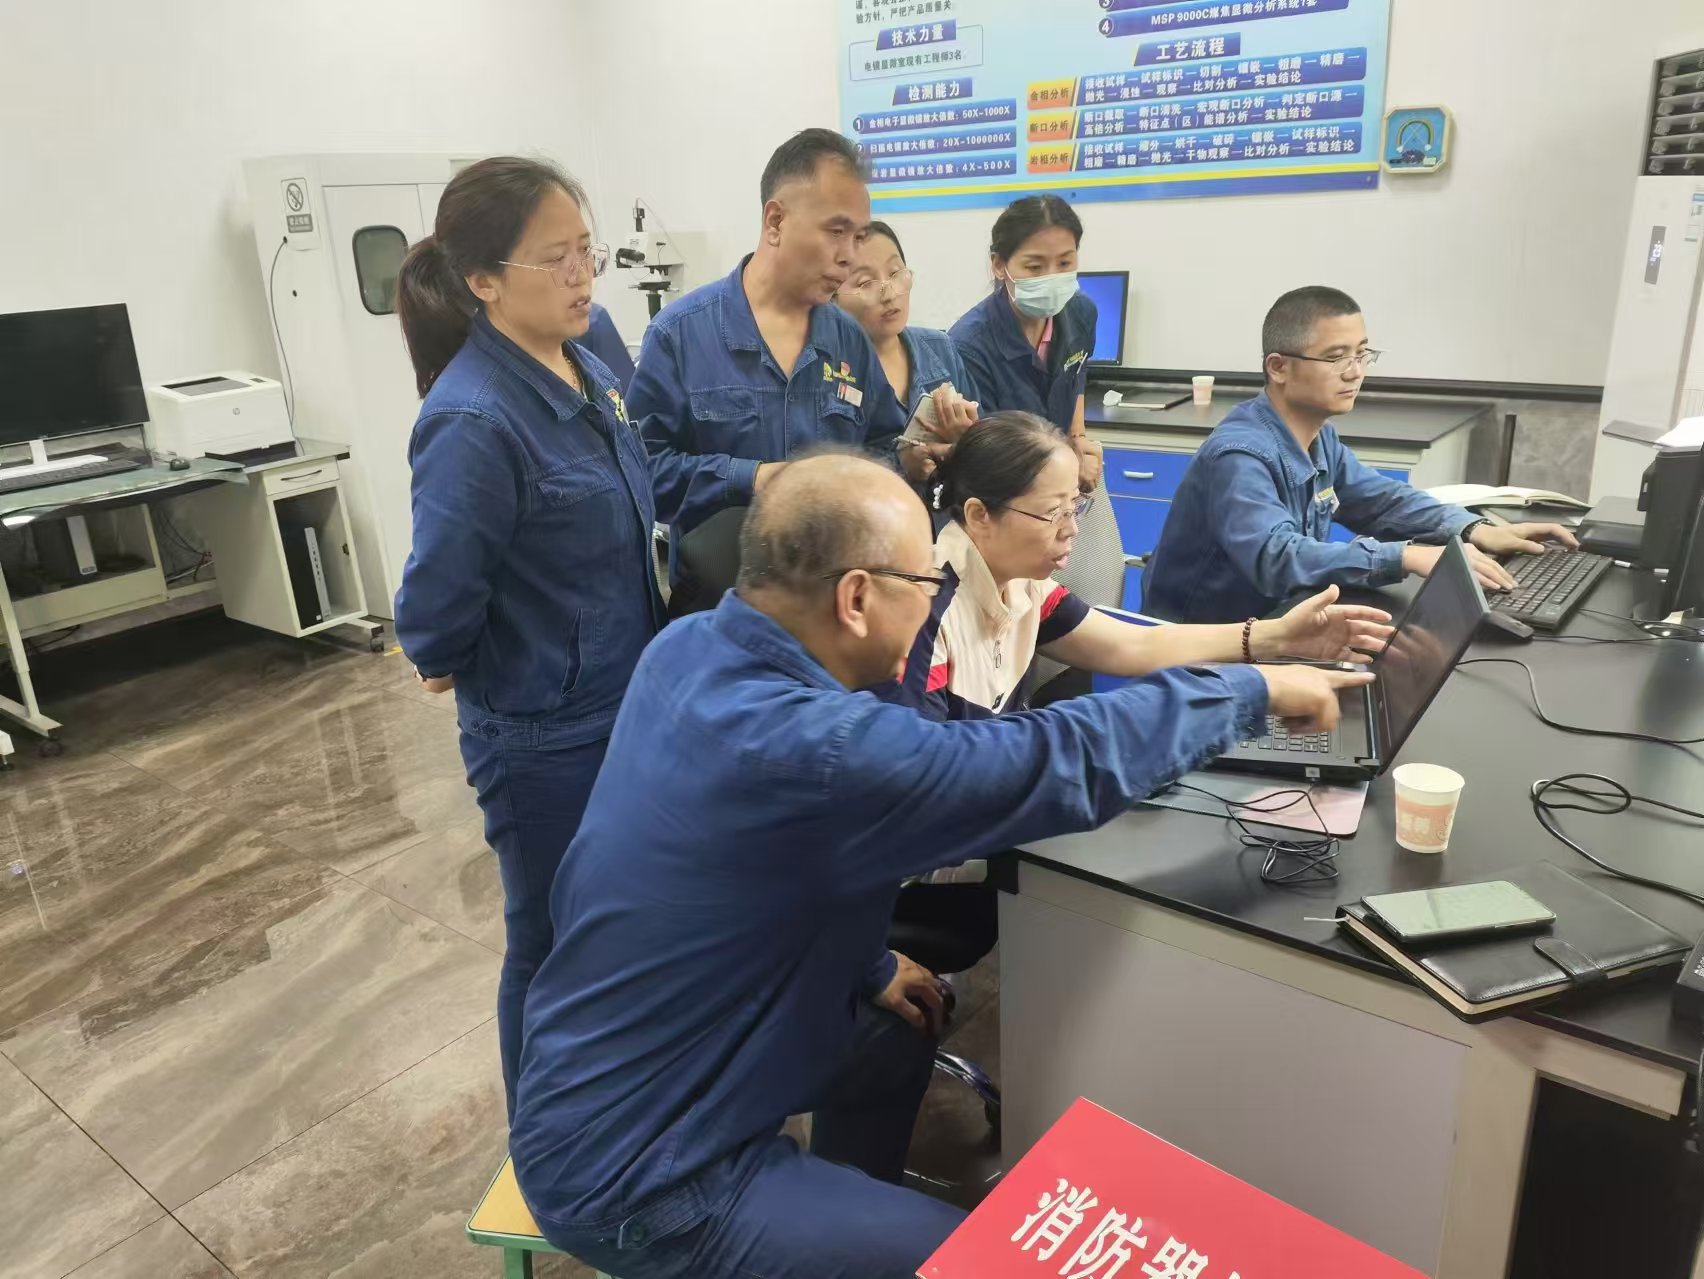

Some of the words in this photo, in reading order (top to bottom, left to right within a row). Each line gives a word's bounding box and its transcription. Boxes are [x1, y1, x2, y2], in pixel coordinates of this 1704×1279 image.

[891, 23, 944, 47] 技术力量
[1156, 37, 1225, 60] 工艺流程
[908, 80, 960, 101] 检测能力
[1030, 87, 1069, 101] 金相分析
[1029, 120, 1070, 133] 断口分析
[1030, 152, 1069, 166] 岩相分析
[1010, 1177, 1240, 1279] 消防器
